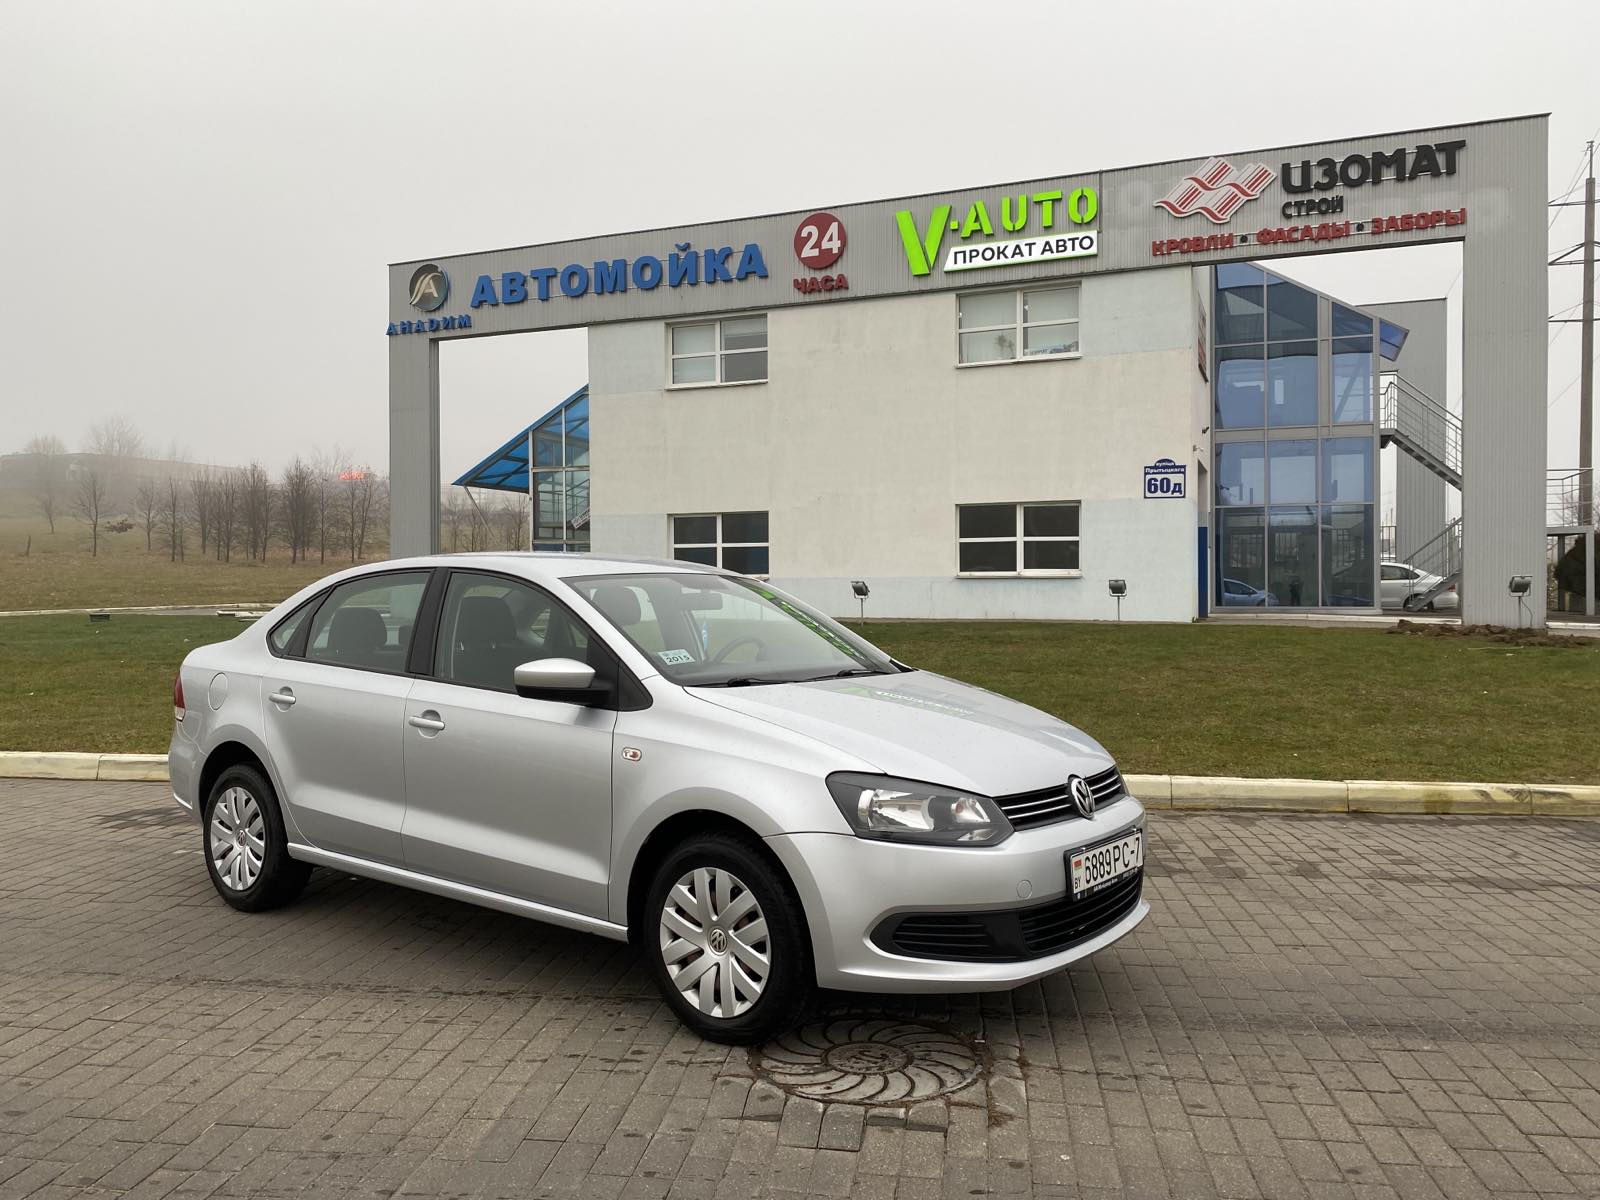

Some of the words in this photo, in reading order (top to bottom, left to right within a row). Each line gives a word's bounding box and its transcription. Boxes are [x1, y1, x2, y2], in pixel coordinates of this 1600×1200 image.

[1282, 195, 1344, 219] СТРОЙ
[800, 222, 841, 258] 24
[1152, 233, 1234, 256] КРОВЛИ
[1256, 221, 1350, 244] ФАСАДЫ
[1371, 208, 1466, 235] ЗАБОРЫ
[953, 242, 1036, 265] ПРОКАТ
[1040, 235, 1094, 256] АВТО
[470, 242, 769, 308] АВТОМОЙКА
[793, 274, 849, 294] ЧАСА
